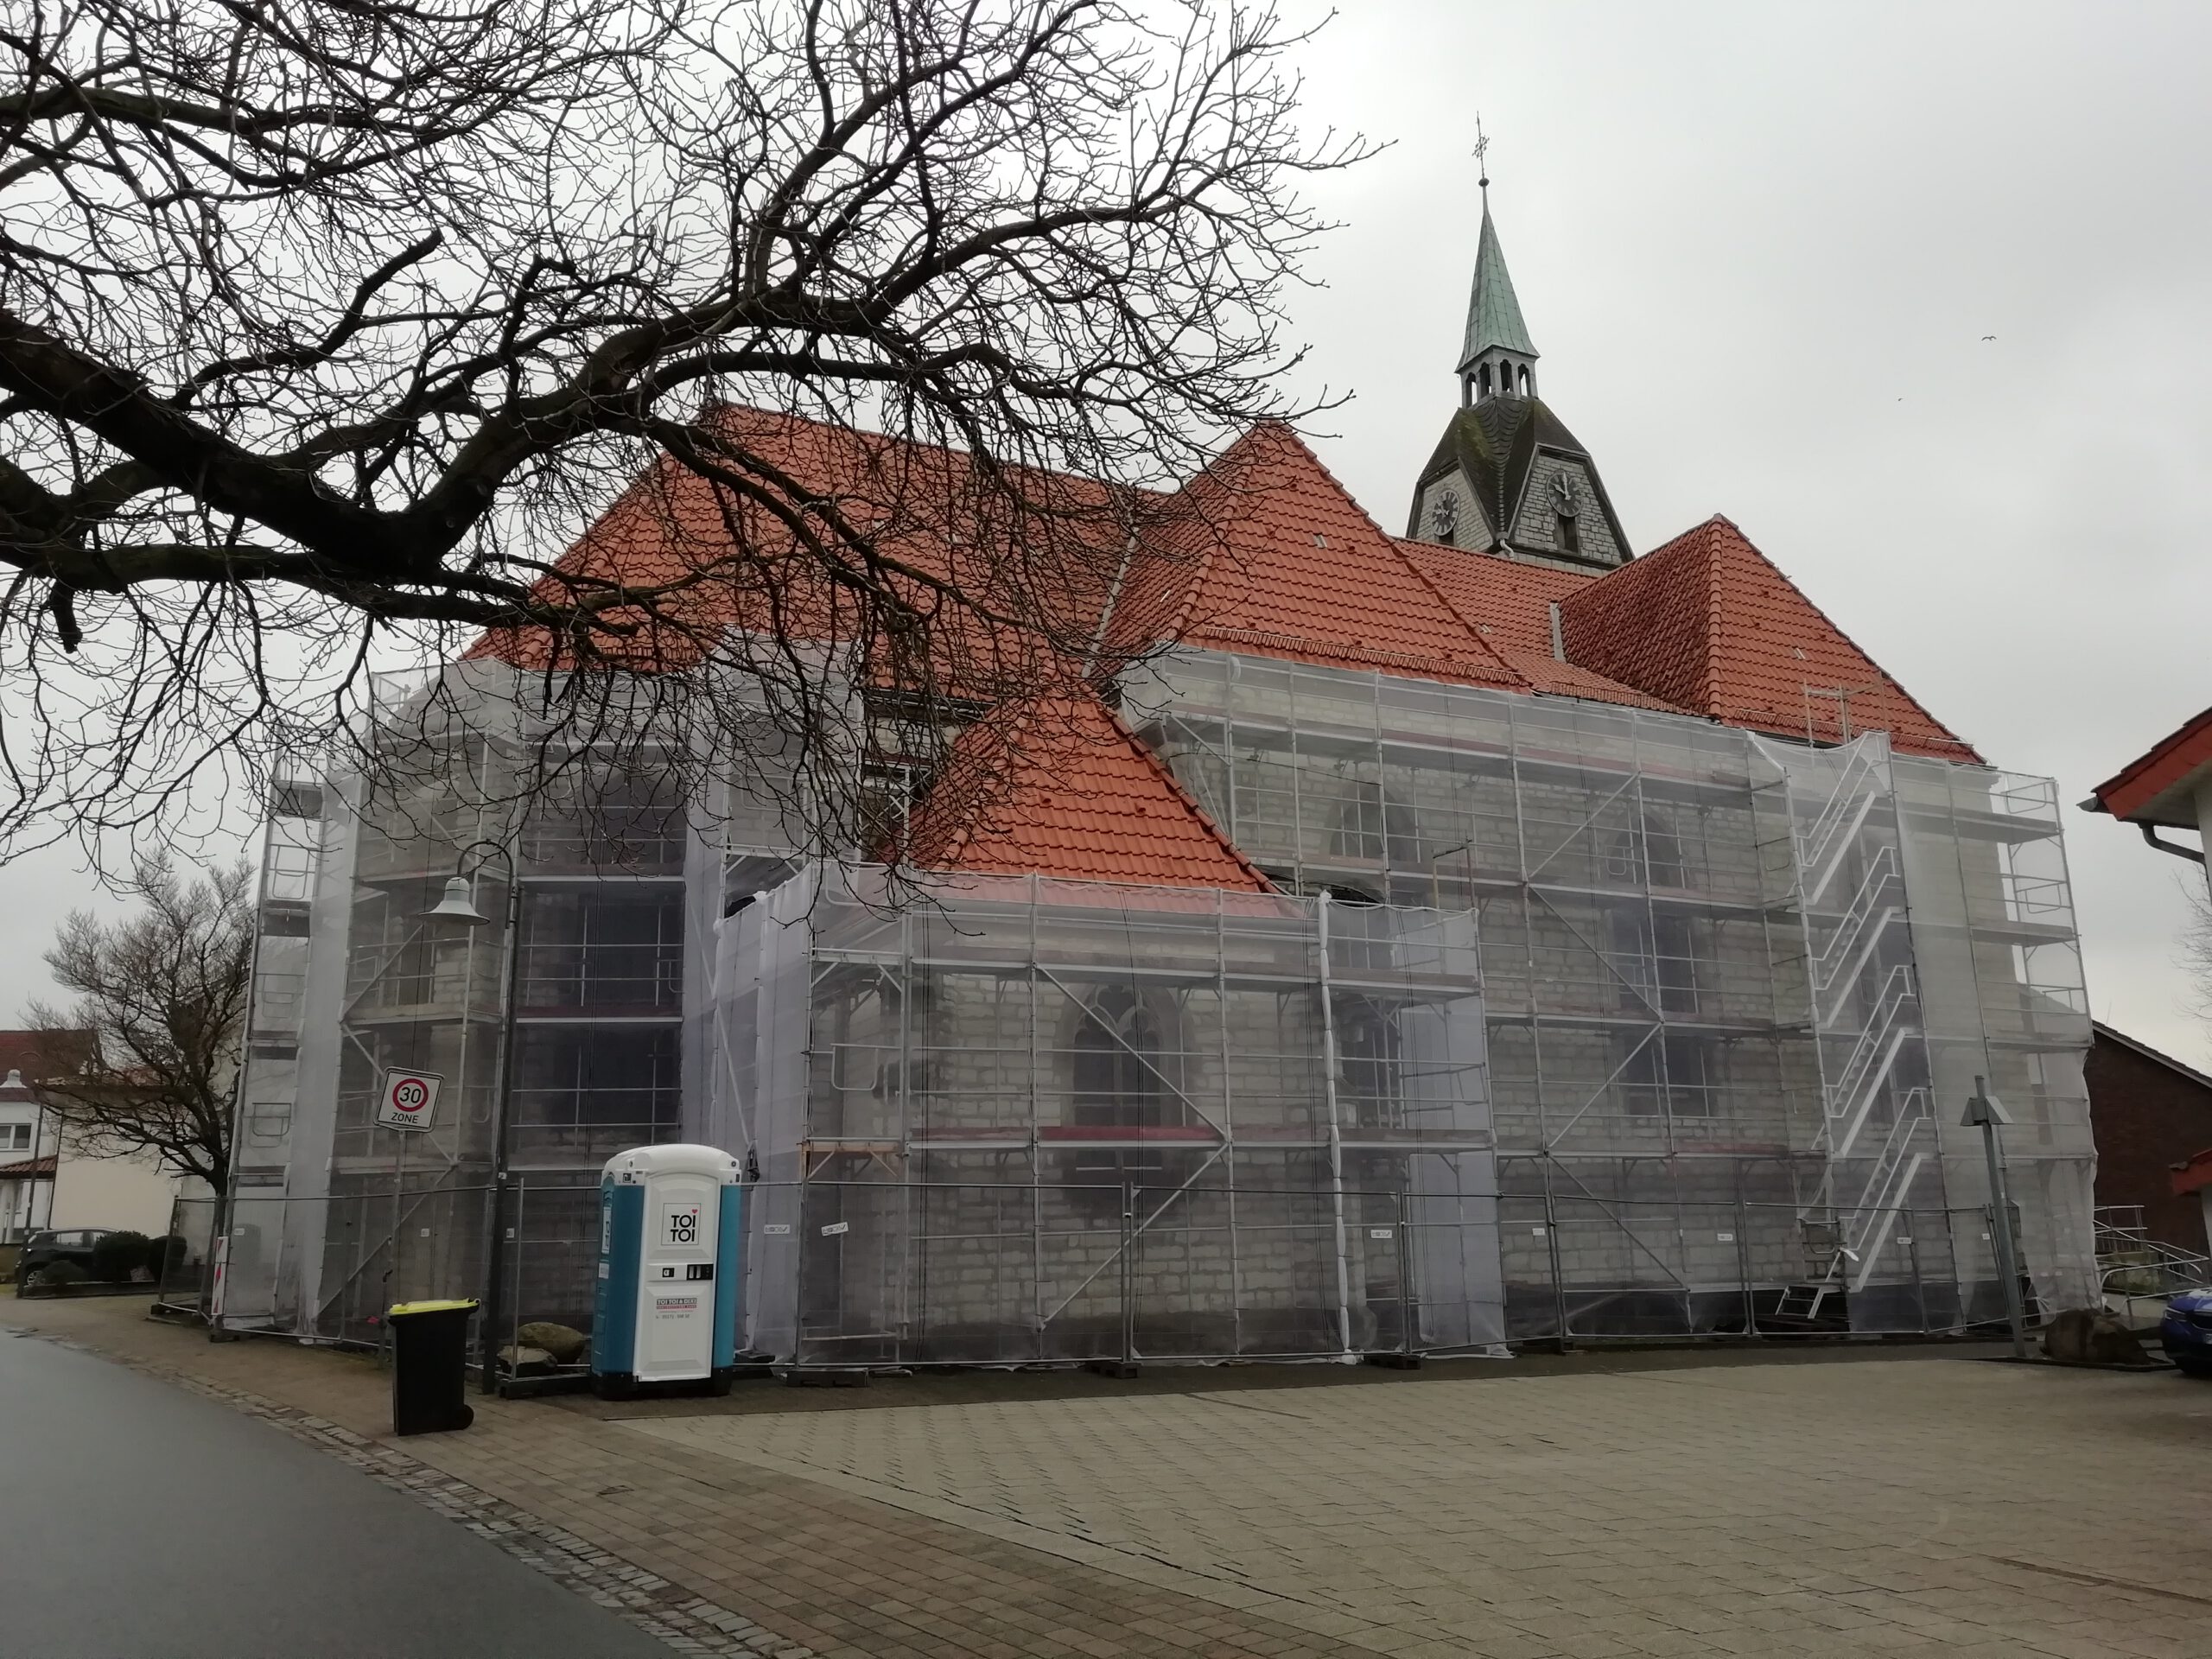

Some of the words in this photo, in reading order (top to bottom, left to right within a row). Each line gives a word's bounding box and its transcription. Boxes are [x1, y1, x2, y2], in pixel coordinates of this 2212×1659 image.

[399, 1087, 422, 1103] 30
[391, 1112, 419, 1124] ZONE
[671, 1215, 696, 1228] TOI
[670, 1229, 695, 1242] TOI
